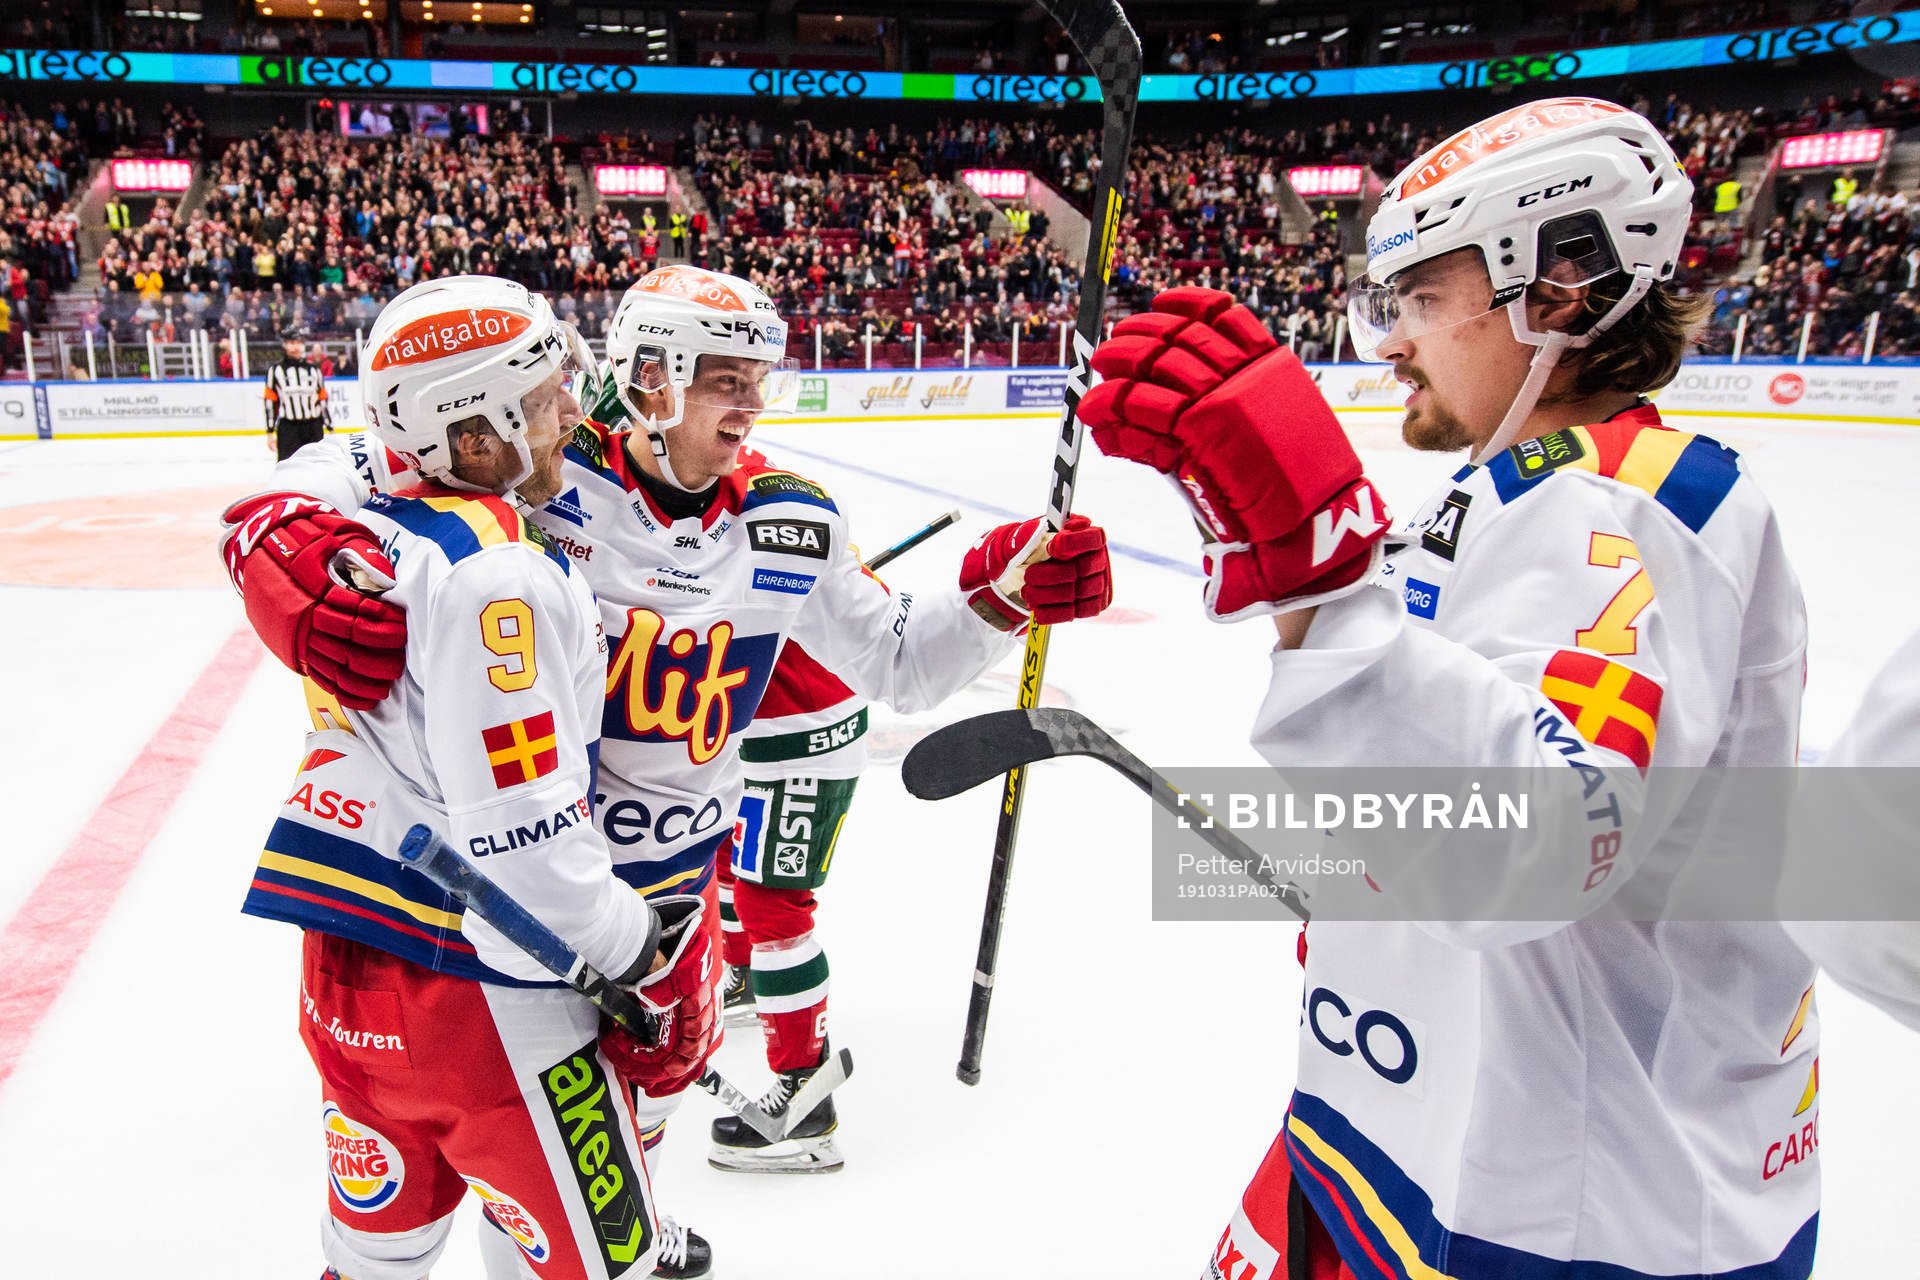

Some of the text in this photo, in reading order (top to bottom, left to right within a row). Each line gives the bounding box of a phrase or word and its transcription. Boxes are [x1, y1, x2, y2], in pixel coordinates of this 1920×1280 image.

[1727, 14, 1901, 63] areco
[257, 55, 393, 86] areco
[511, 62, 638, 92] areco
[749, 69, 867, 98] areco
[1194, 69, 1317, 100] areco
[1438, 50, 1581, 89] areco
[972, 74, 1087, 101] areco
[1415, 101, 1602, 186] navigator
[1517, 174, 1593, 208] CCM
[635, 273, 735, 306] navigator
[1494, 285, 1524, 301] CCM
[383, 314, 511, 364] navigator
[637, 323, 676, 336] CCM
[436, 392, 487, 413] CCM
[756, 525, 820, 550] RSA
[657, 579, 712, 596] MonkeySports
[757, 574, 814, 591] EHRENBORG
[1575, 531, 1656, 656] 7
[480, 598, 539, 694] 9
[808, 716, 860, 753] SKF
[325, 1131, 381, 1155] BURGER
[547, 1055, 625, 1215] akea
[330, 1153, 389, 1179] KING
